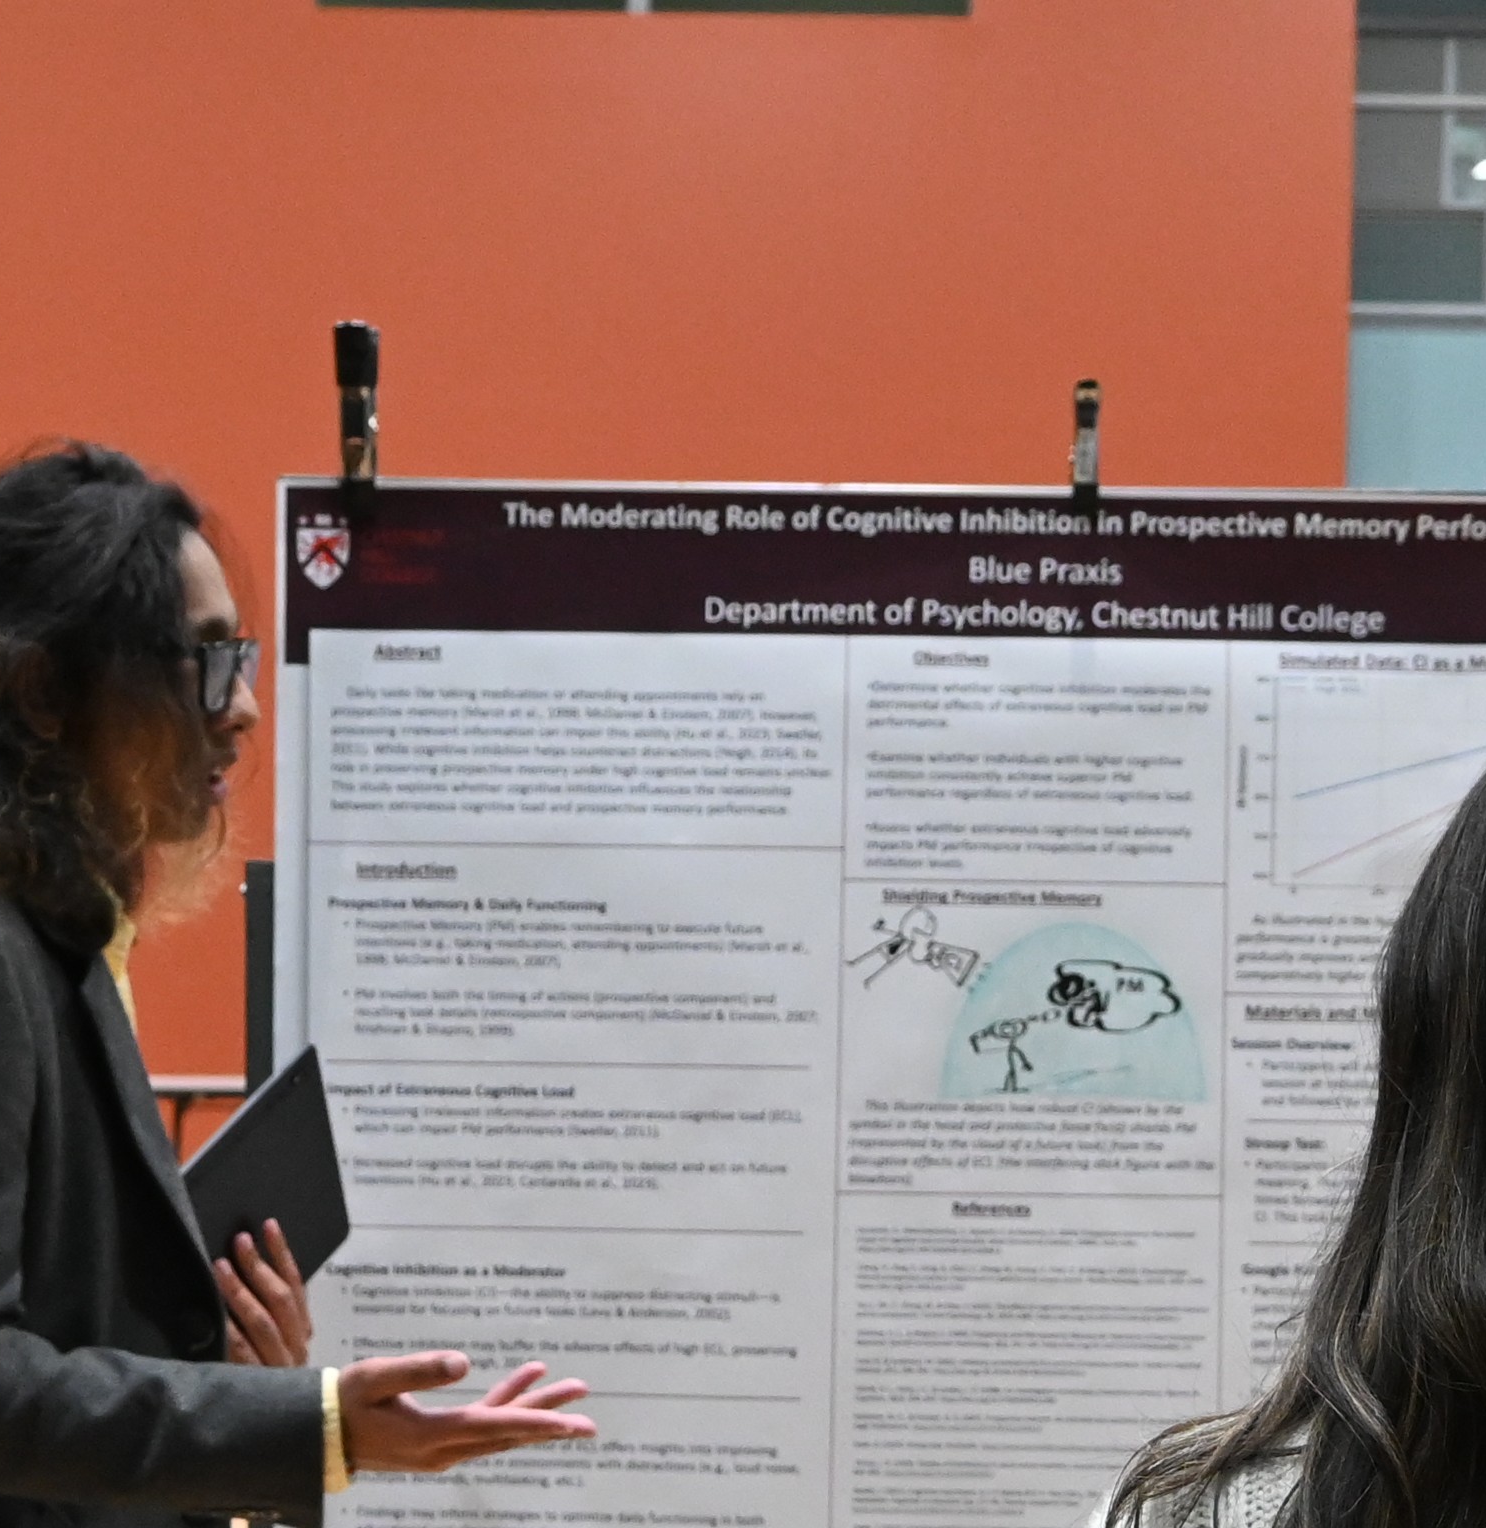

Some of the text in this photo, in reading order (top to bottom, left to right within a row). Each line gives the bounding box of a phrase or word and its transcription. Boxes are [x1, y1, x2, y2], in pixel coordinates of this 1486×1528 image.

[502, 502, 553, 530] The
[559, 503, 718, 537] Moderating
[724, 505, 785, 533] Role
[791, 506, 820, 533] of
[826, 506, 952, 540] Cognitive
[958, 508, 1090, 537] Inhibition
[1096, 510, 1123, 537] in
[1129, 510, 1287, 544] Prospective
[1293, 514, 1409, 546] Memory
[968, 556, 1123, 585] Blue Praxis
[704, 596, 1385, 641] Department of Psychology, Chestnut Hill College
[373, 643, 442, 660] Abstract
[355, 861, 457, 878] Introduction
